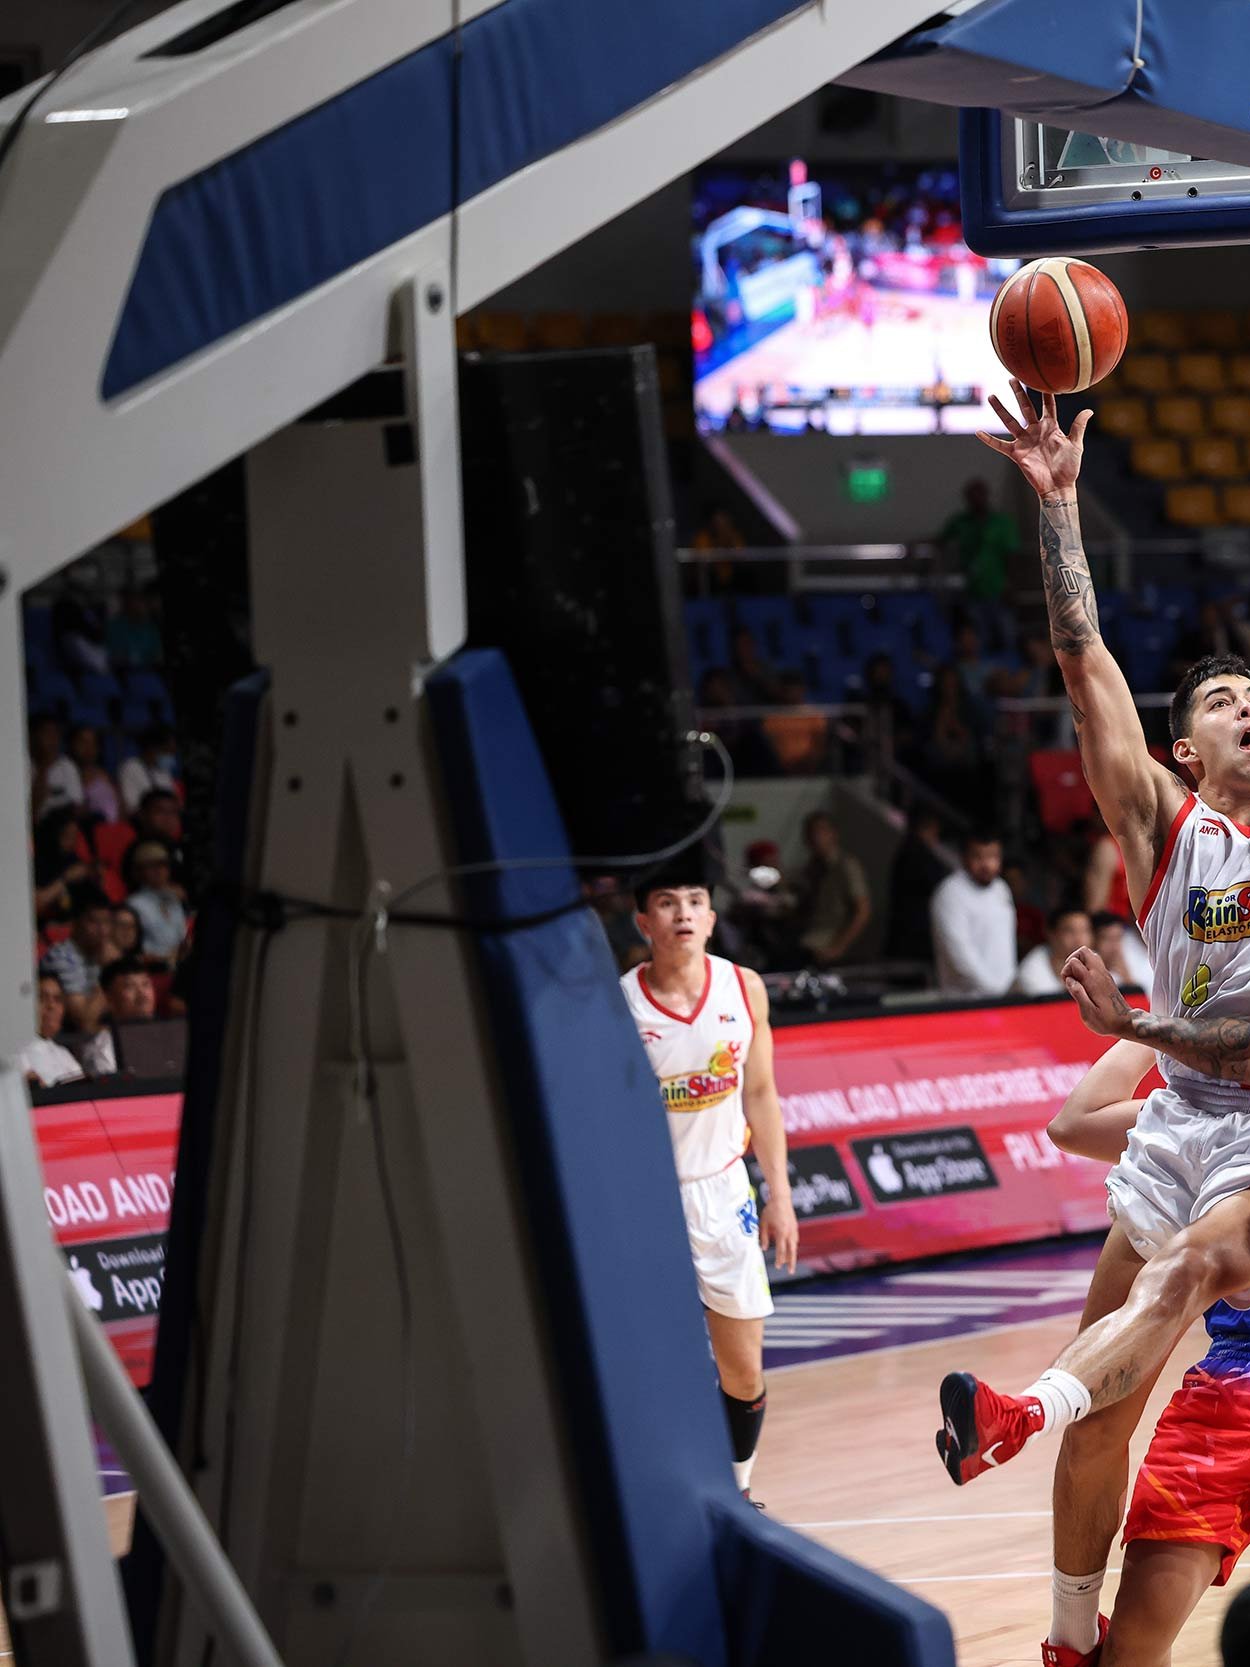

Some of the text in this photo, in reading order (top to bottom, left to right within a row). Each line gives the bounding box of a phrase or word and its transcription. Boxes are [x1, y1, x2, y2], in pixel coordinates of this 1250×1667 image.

[1199, 825, 1219, 836] ANTA
[1188, 887, 1236, 934] Rain
[1224, 894, 1236, 902] OR
[1206, 921, 1246, 940] ELASTO
[110, 1172, 171, 1218] AND
[111, 1274, 162, 1312] App
